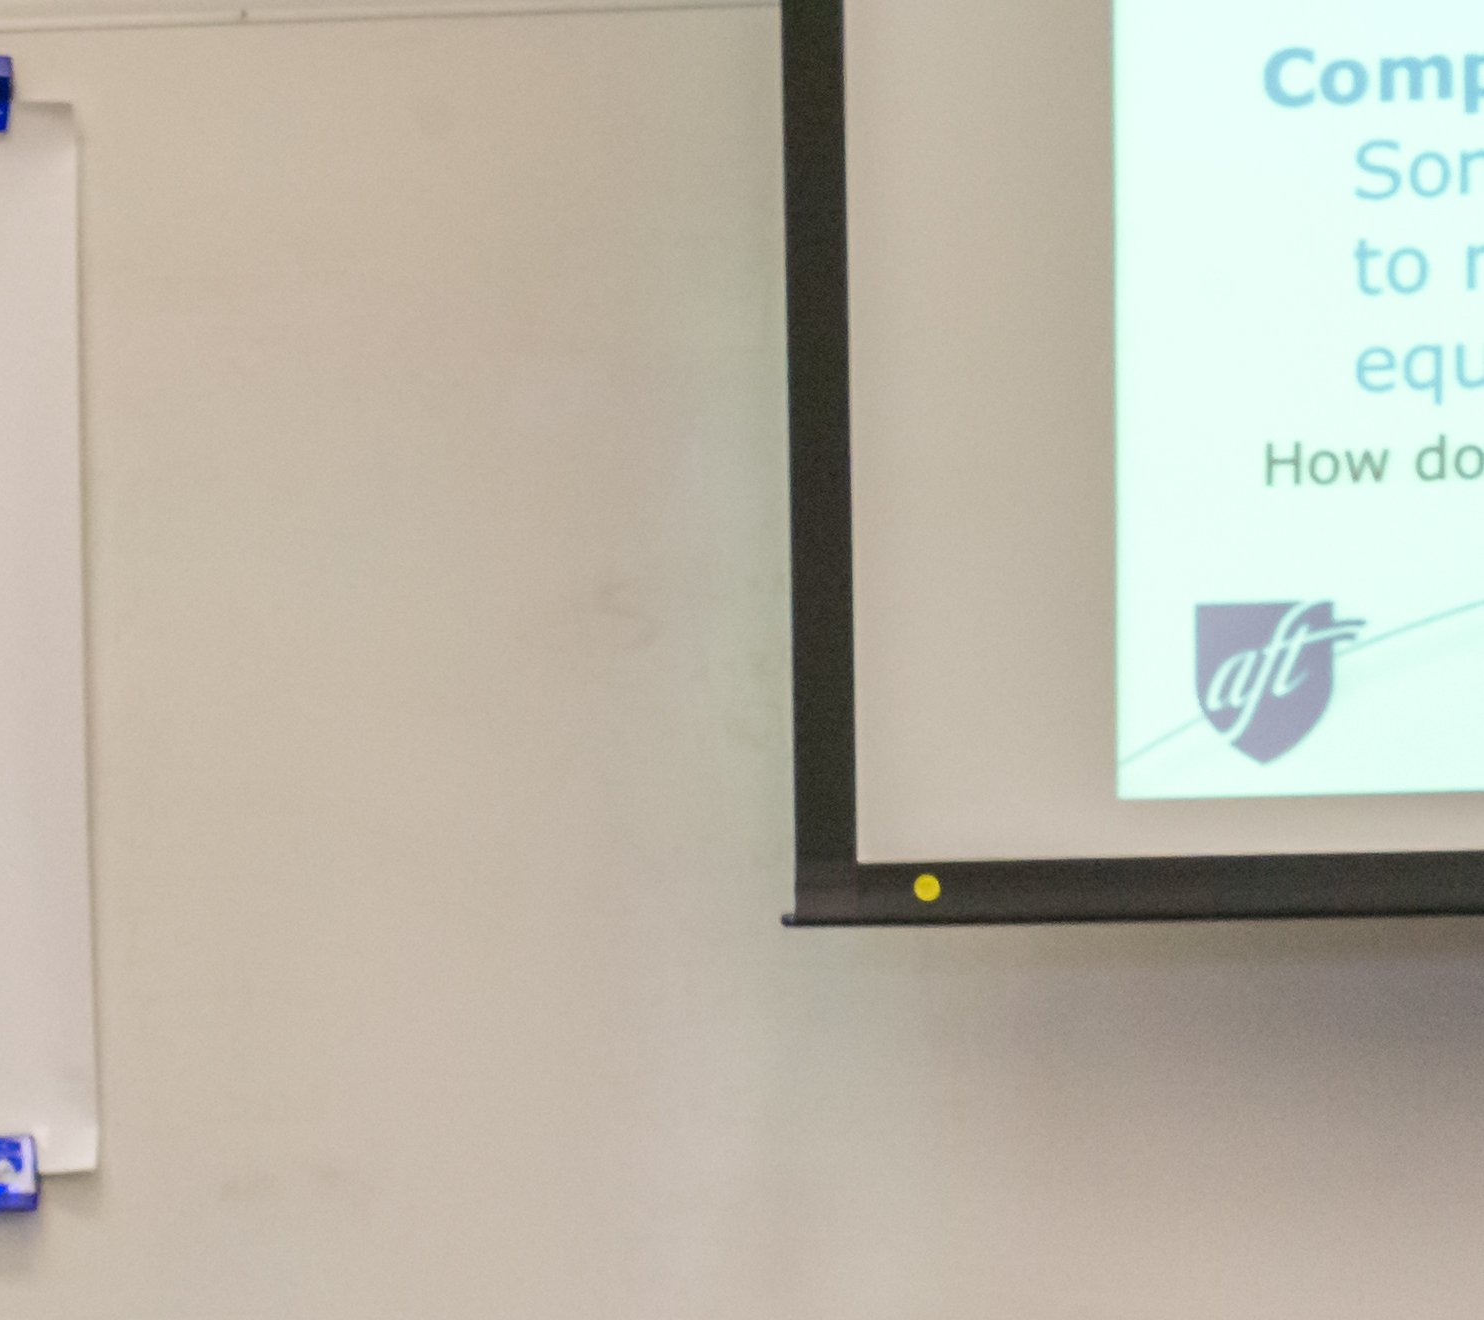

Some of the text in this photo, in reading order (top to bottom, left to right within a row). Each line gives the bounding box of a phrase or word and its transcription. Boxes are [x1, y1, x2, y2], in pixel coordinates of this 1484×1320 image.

[1354, 238, 1429, 296] to
[1265, 434, 1484, 486] How do
[1204, 600, 1368, 743] aft
